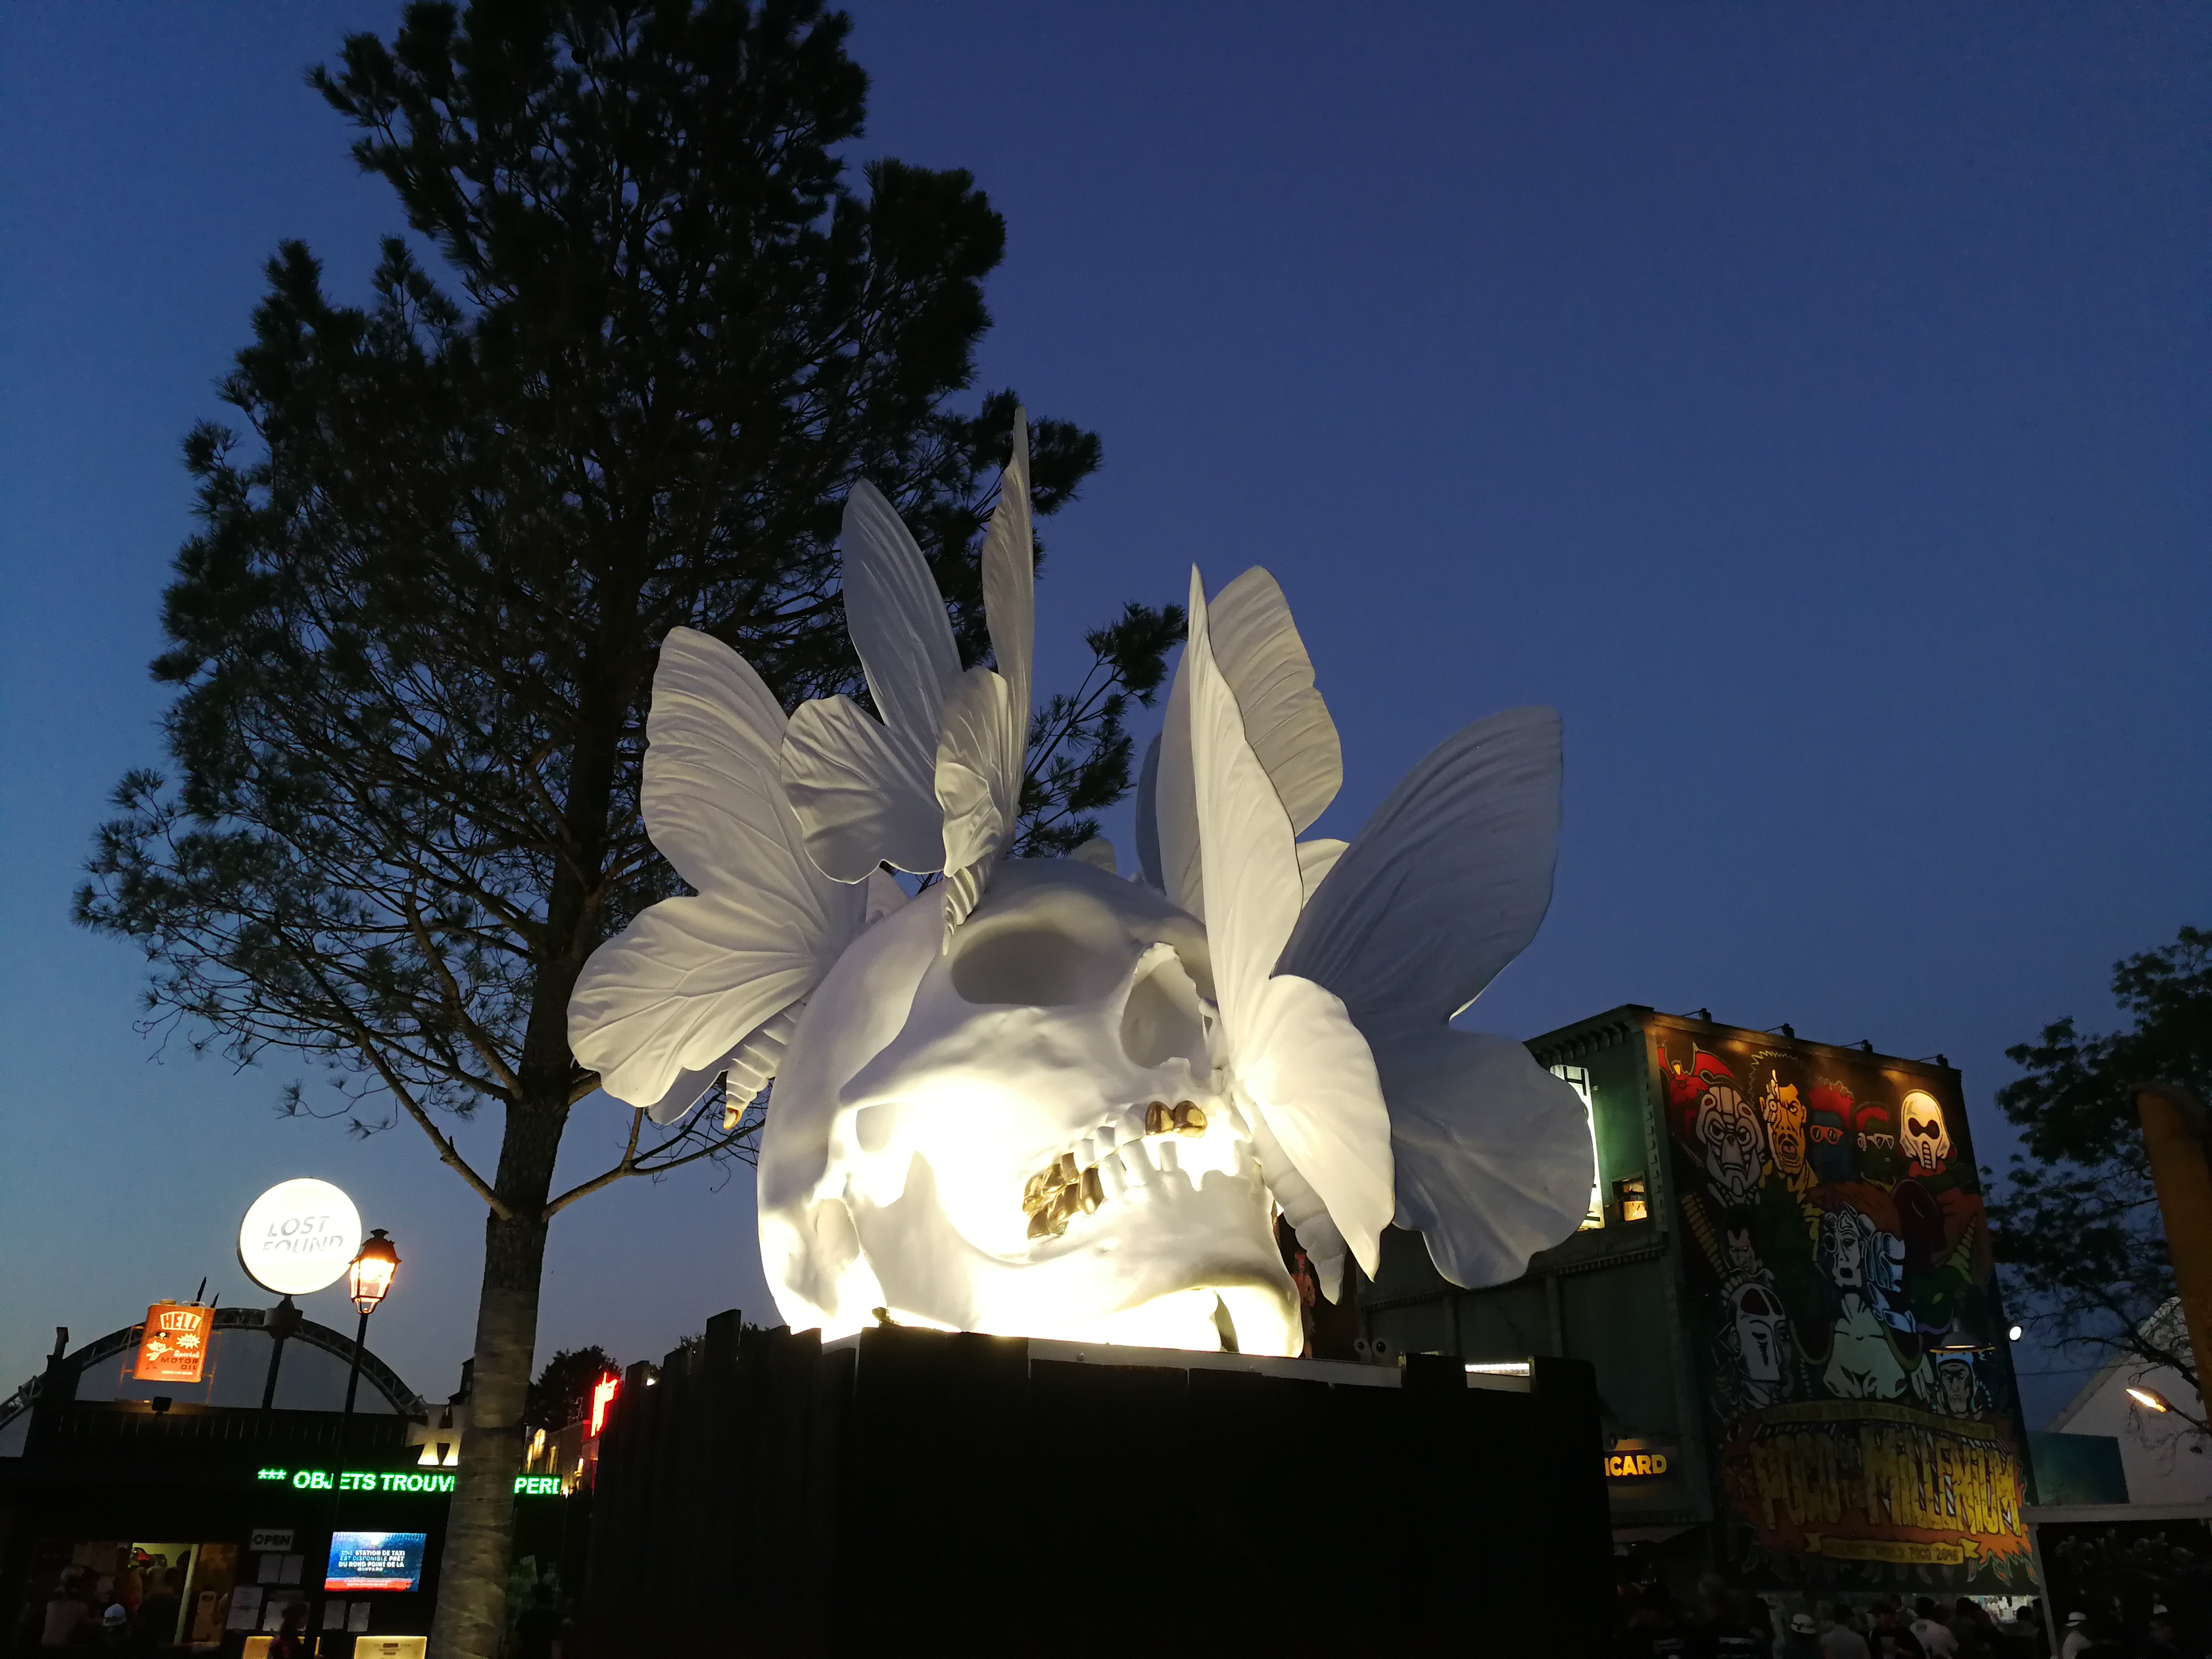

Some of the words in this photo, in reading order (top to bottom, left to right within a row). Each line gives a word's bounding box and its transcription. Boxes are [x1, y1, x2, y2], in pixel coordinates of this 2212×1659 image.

[267, 1216, 330, 1237] LOST
[262, 1235, 343, 1254] FOUND
[163, 1313, 197, 1330] HELL
[174, 1350, 200, 1358] Special
[1604, 1454, 1667, 1477] ICARD
[293, 1471, 376, 1491] OBJETS
[380, 1474, 455, 1492] TROUV
[253, 1534, 291, 1545] OPEN
